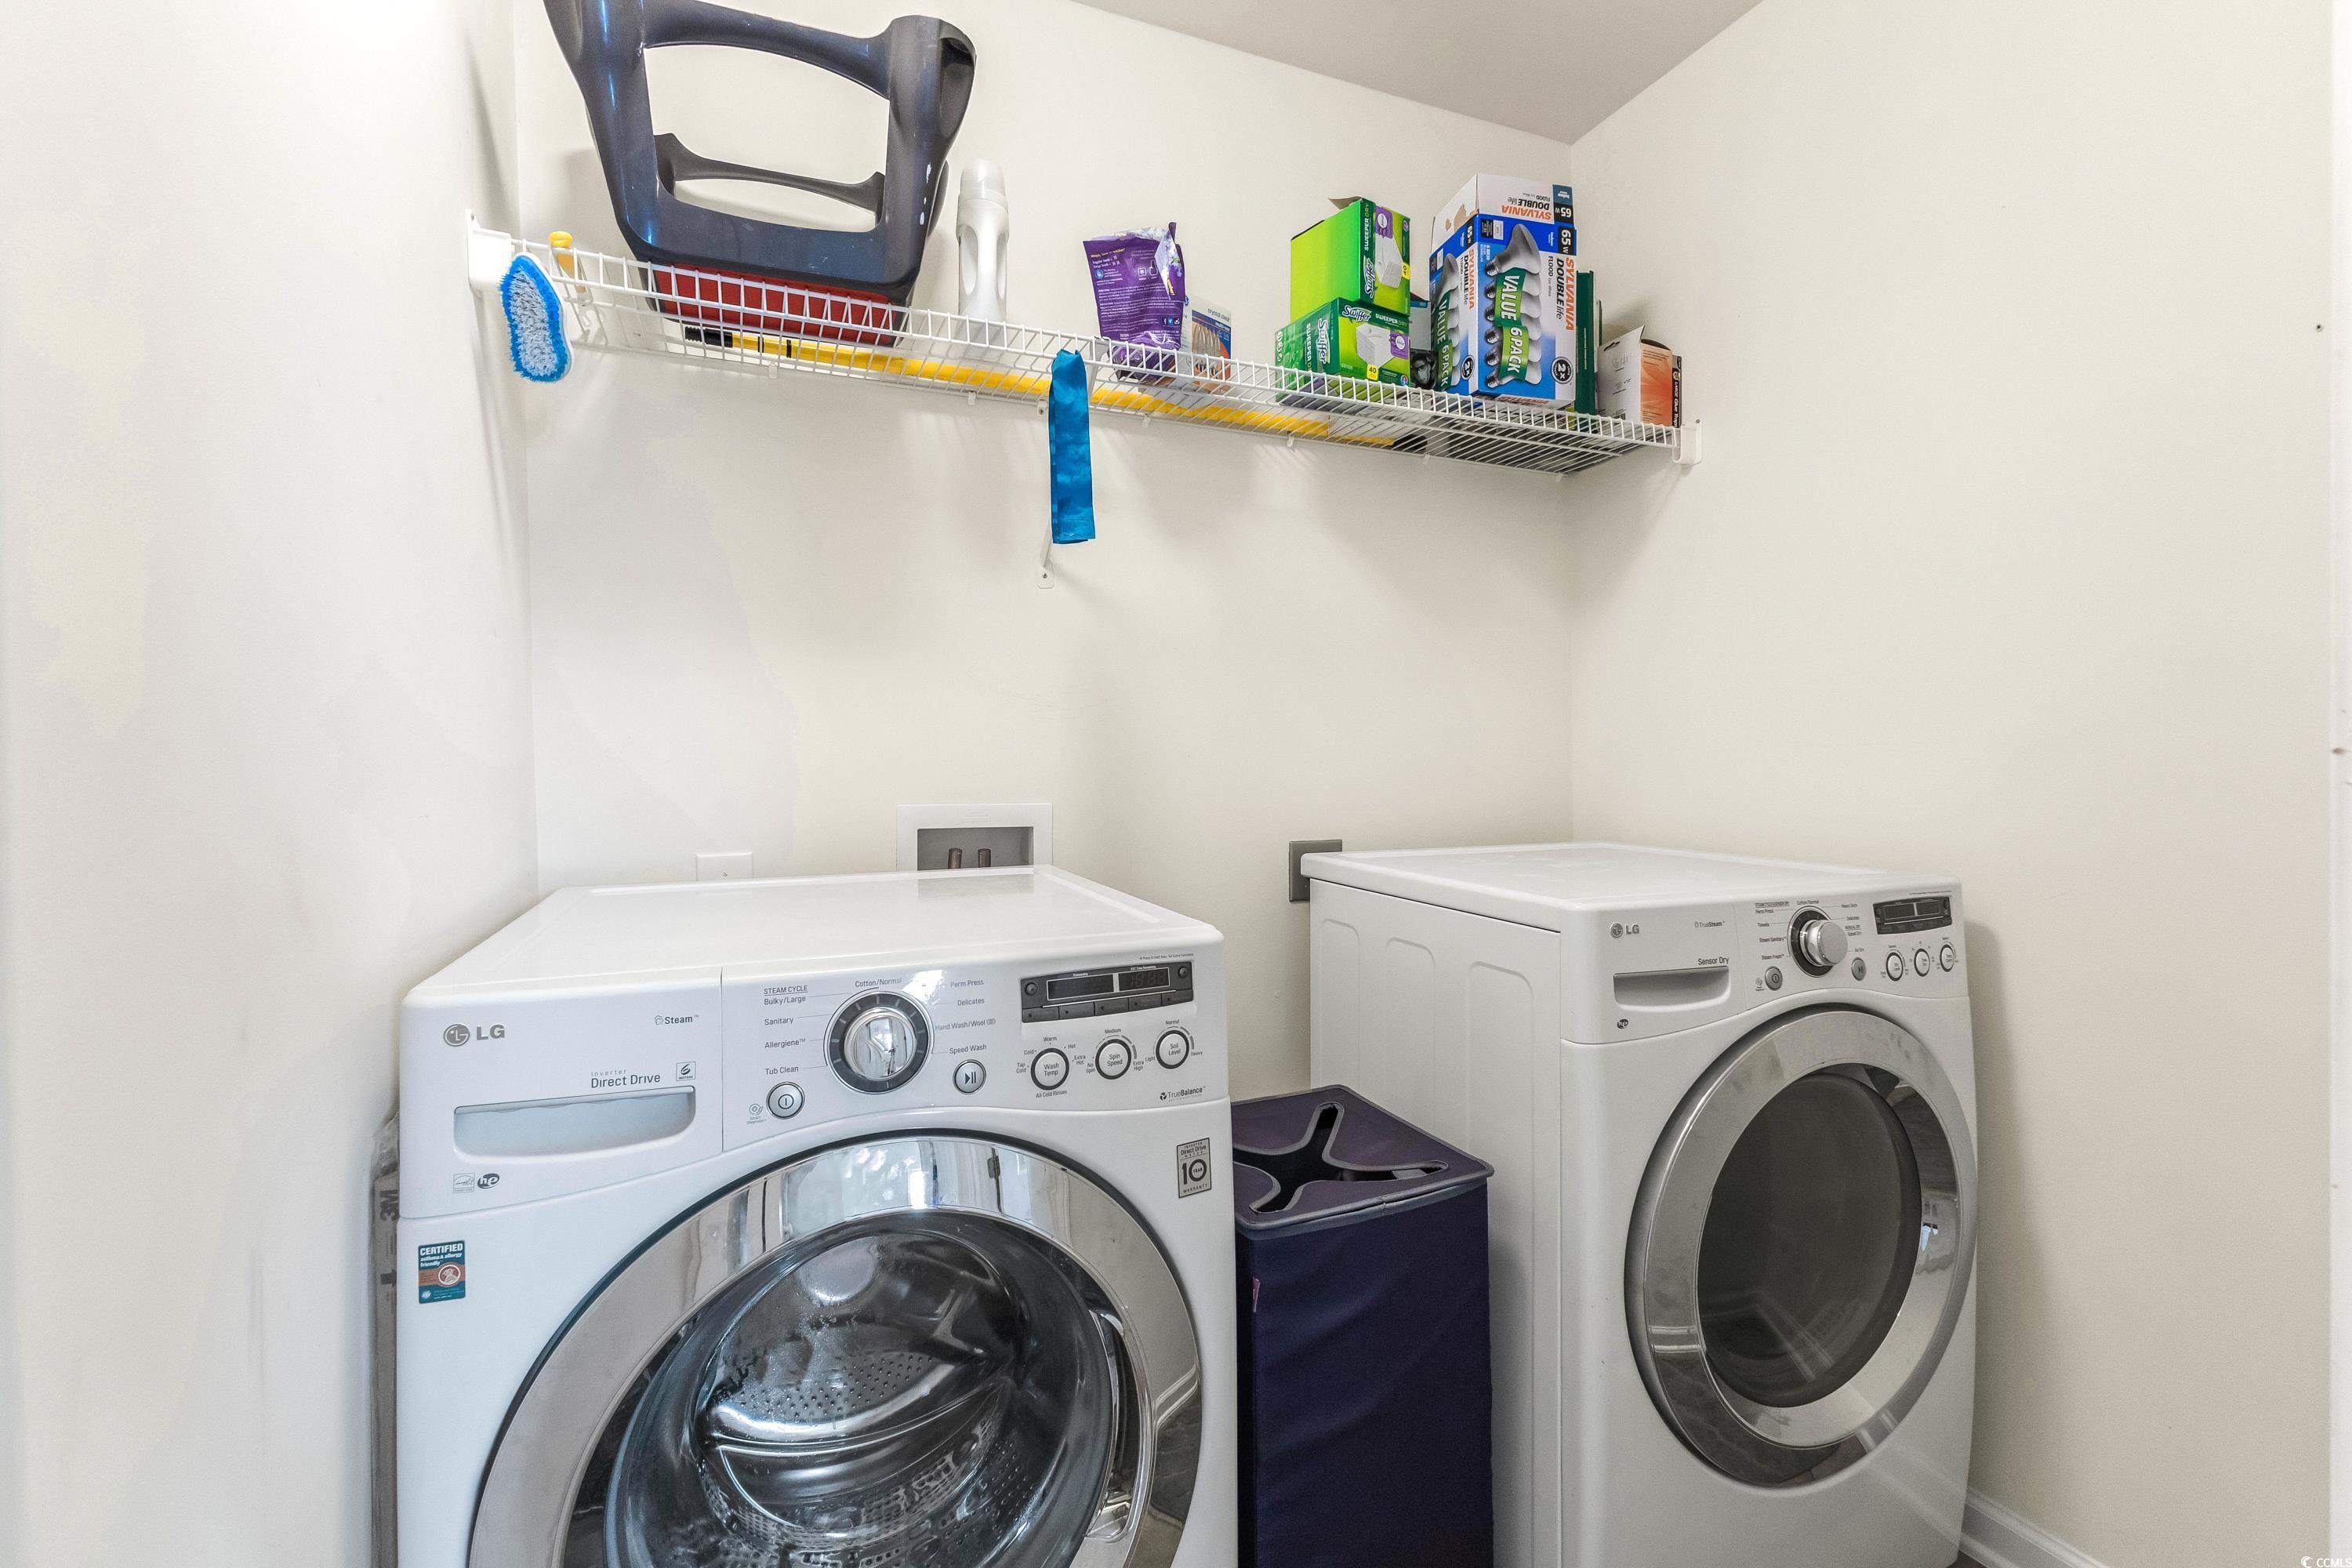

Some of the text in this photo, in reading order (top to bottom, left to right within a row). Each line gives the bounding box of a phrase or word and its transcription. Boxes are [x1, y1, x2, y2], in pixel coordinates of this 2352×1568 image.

[1501, 205, 1552, 220] SYLVANIA
[1403, 265, 1407, 275] 40
[1365, 257, 1375, 299] Swiffer
[1501, 275, 1520, 321] VALUE
[1566, 257, 1574, 331] SYLVANIA
[1342, 305, 1372, 322] Swiffer
[1375, 314, 1398, 325] SWEEPER
[1436, 299, 1447, 345] VALUE
[1316, 318, 1328, 364] Swiffer
[1625, 924, 1639, 935] LG
[855, 978, 902, 987] Cotton/Normal
[764, 996, 806, 1005] Bulky/Large
[952, 1019, 985, 1029] Wash/Wool
[476, 1024, 505, 1041] LG
[949, 1046, 968, 1054] Speed
[591, 1074, 661, 1088] Direct Drive
[1168, 1087, 1203, 1098] TrueBalance
[1181, 1147, 1194, 1156] Direct
[1182, 1159, 1207, 1185] 10
[478, 1174, 499, 1188] he
[379, 1190, 397, 1221] 3M
[419, 1243, 463, 1256] CERTIFIED
